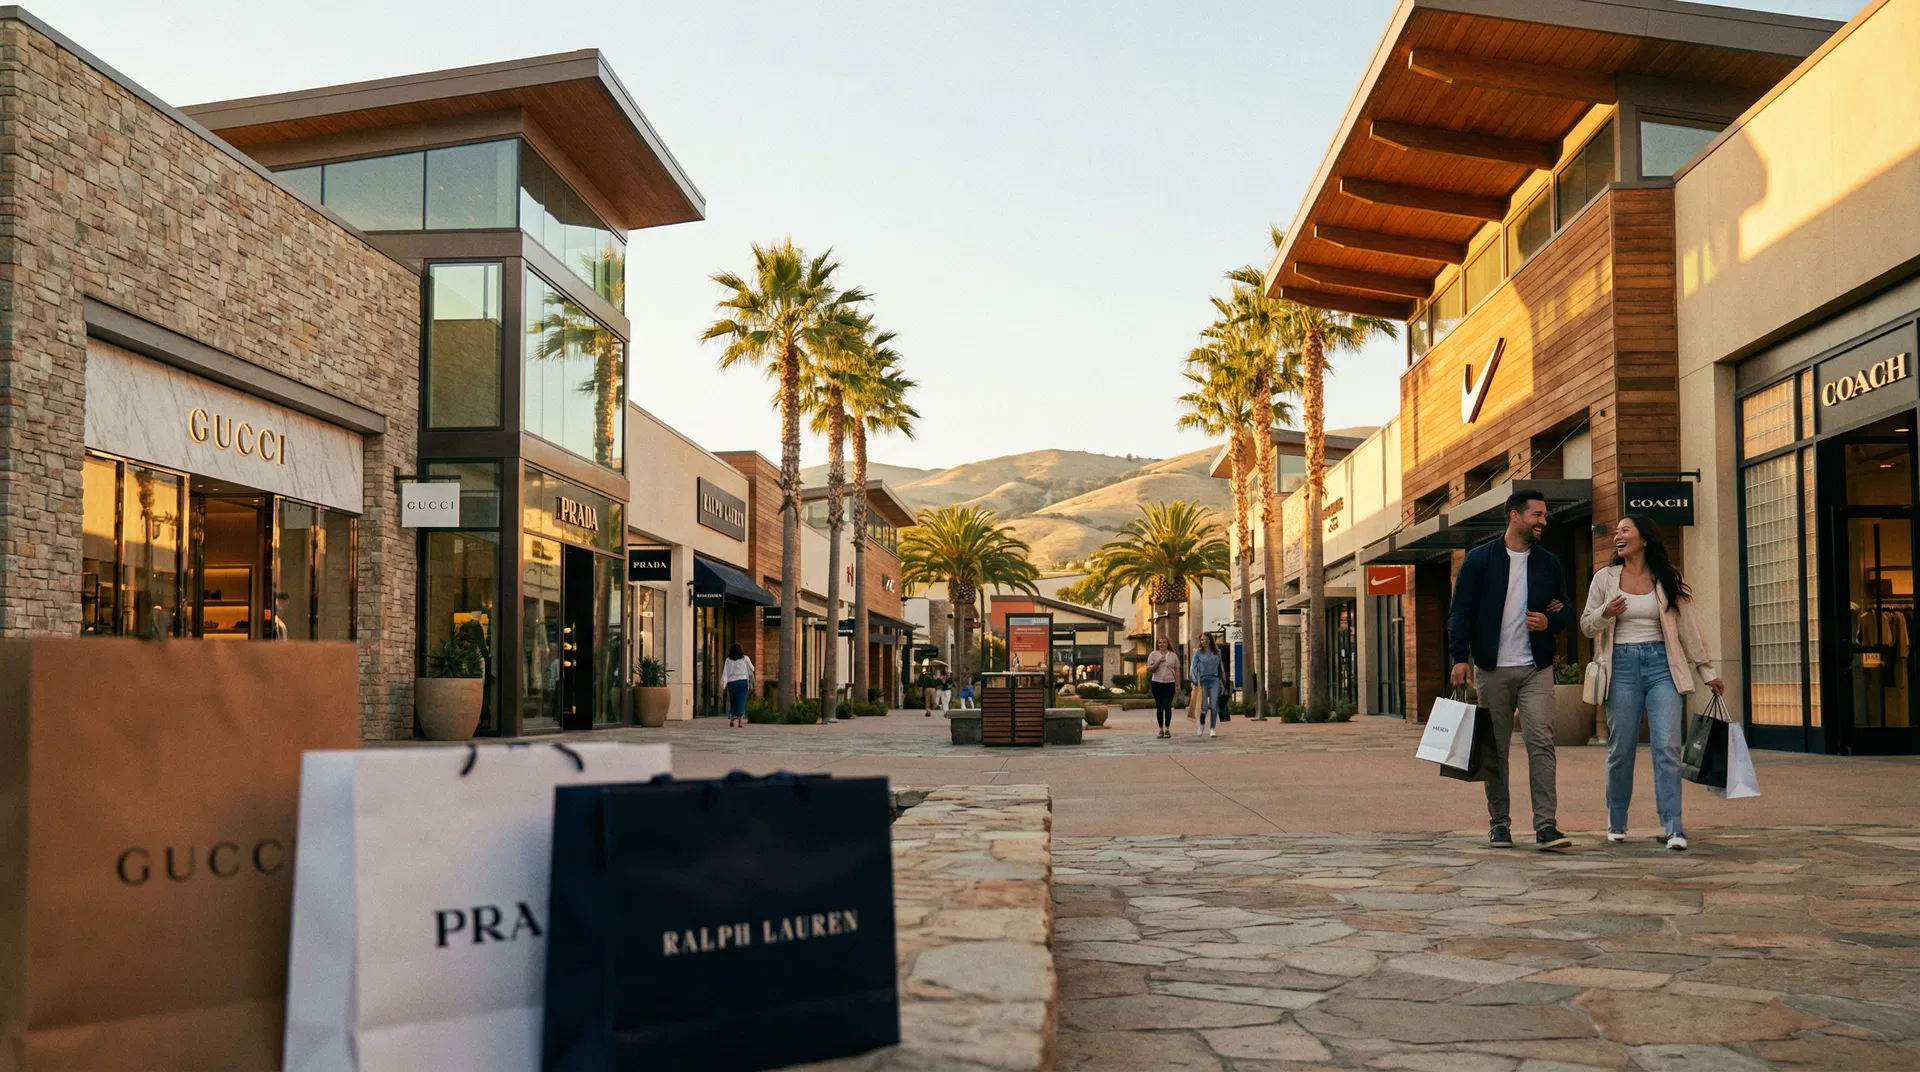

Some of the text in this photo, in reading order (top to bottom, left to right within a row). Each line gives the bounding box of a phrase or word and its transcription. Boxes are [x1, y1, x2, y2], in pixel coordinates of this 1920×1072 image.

[1821, 352, 1907, 407] COACH
[188, 407, 285, 466] GUCCI
[407, 500, 454, 510] GUCCI
[561, 496, 599, 532] PRADA
[1629, 498, 1689, 508] COACH
[633, 561, 667, 569] PRADA
[115, 837, 294, 887] GUCC
[662, 908, 860, 957] RALPH LAUREN
